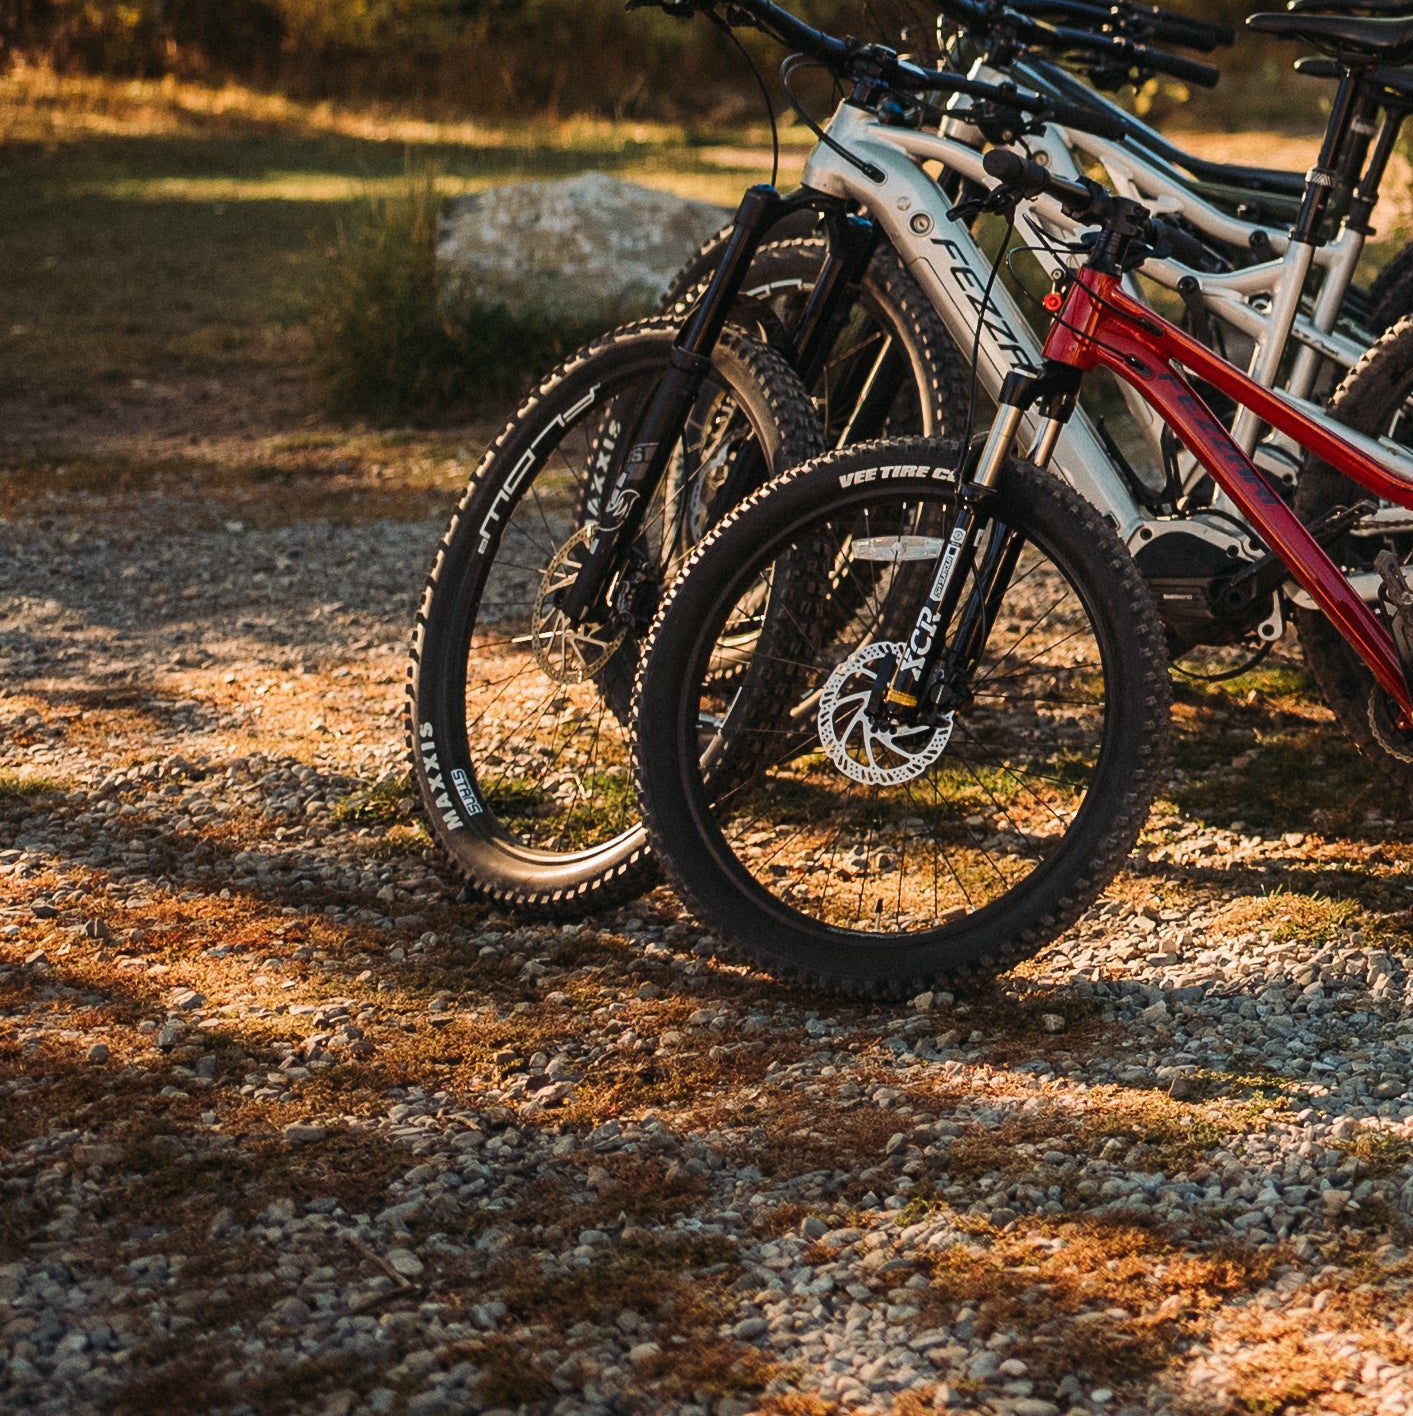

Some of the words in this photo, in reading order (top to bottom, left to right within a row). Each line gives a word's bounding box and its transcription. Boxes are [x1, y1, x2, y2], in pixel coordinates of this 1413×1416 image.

[839, 467, 877, 488] VEE
[880, 465, 930, 479] TIRE
[900, 606, 942, 682] XCR
[420, 721, 464, 831] MAXXIS
[451, 769, 481, 815] STANS
